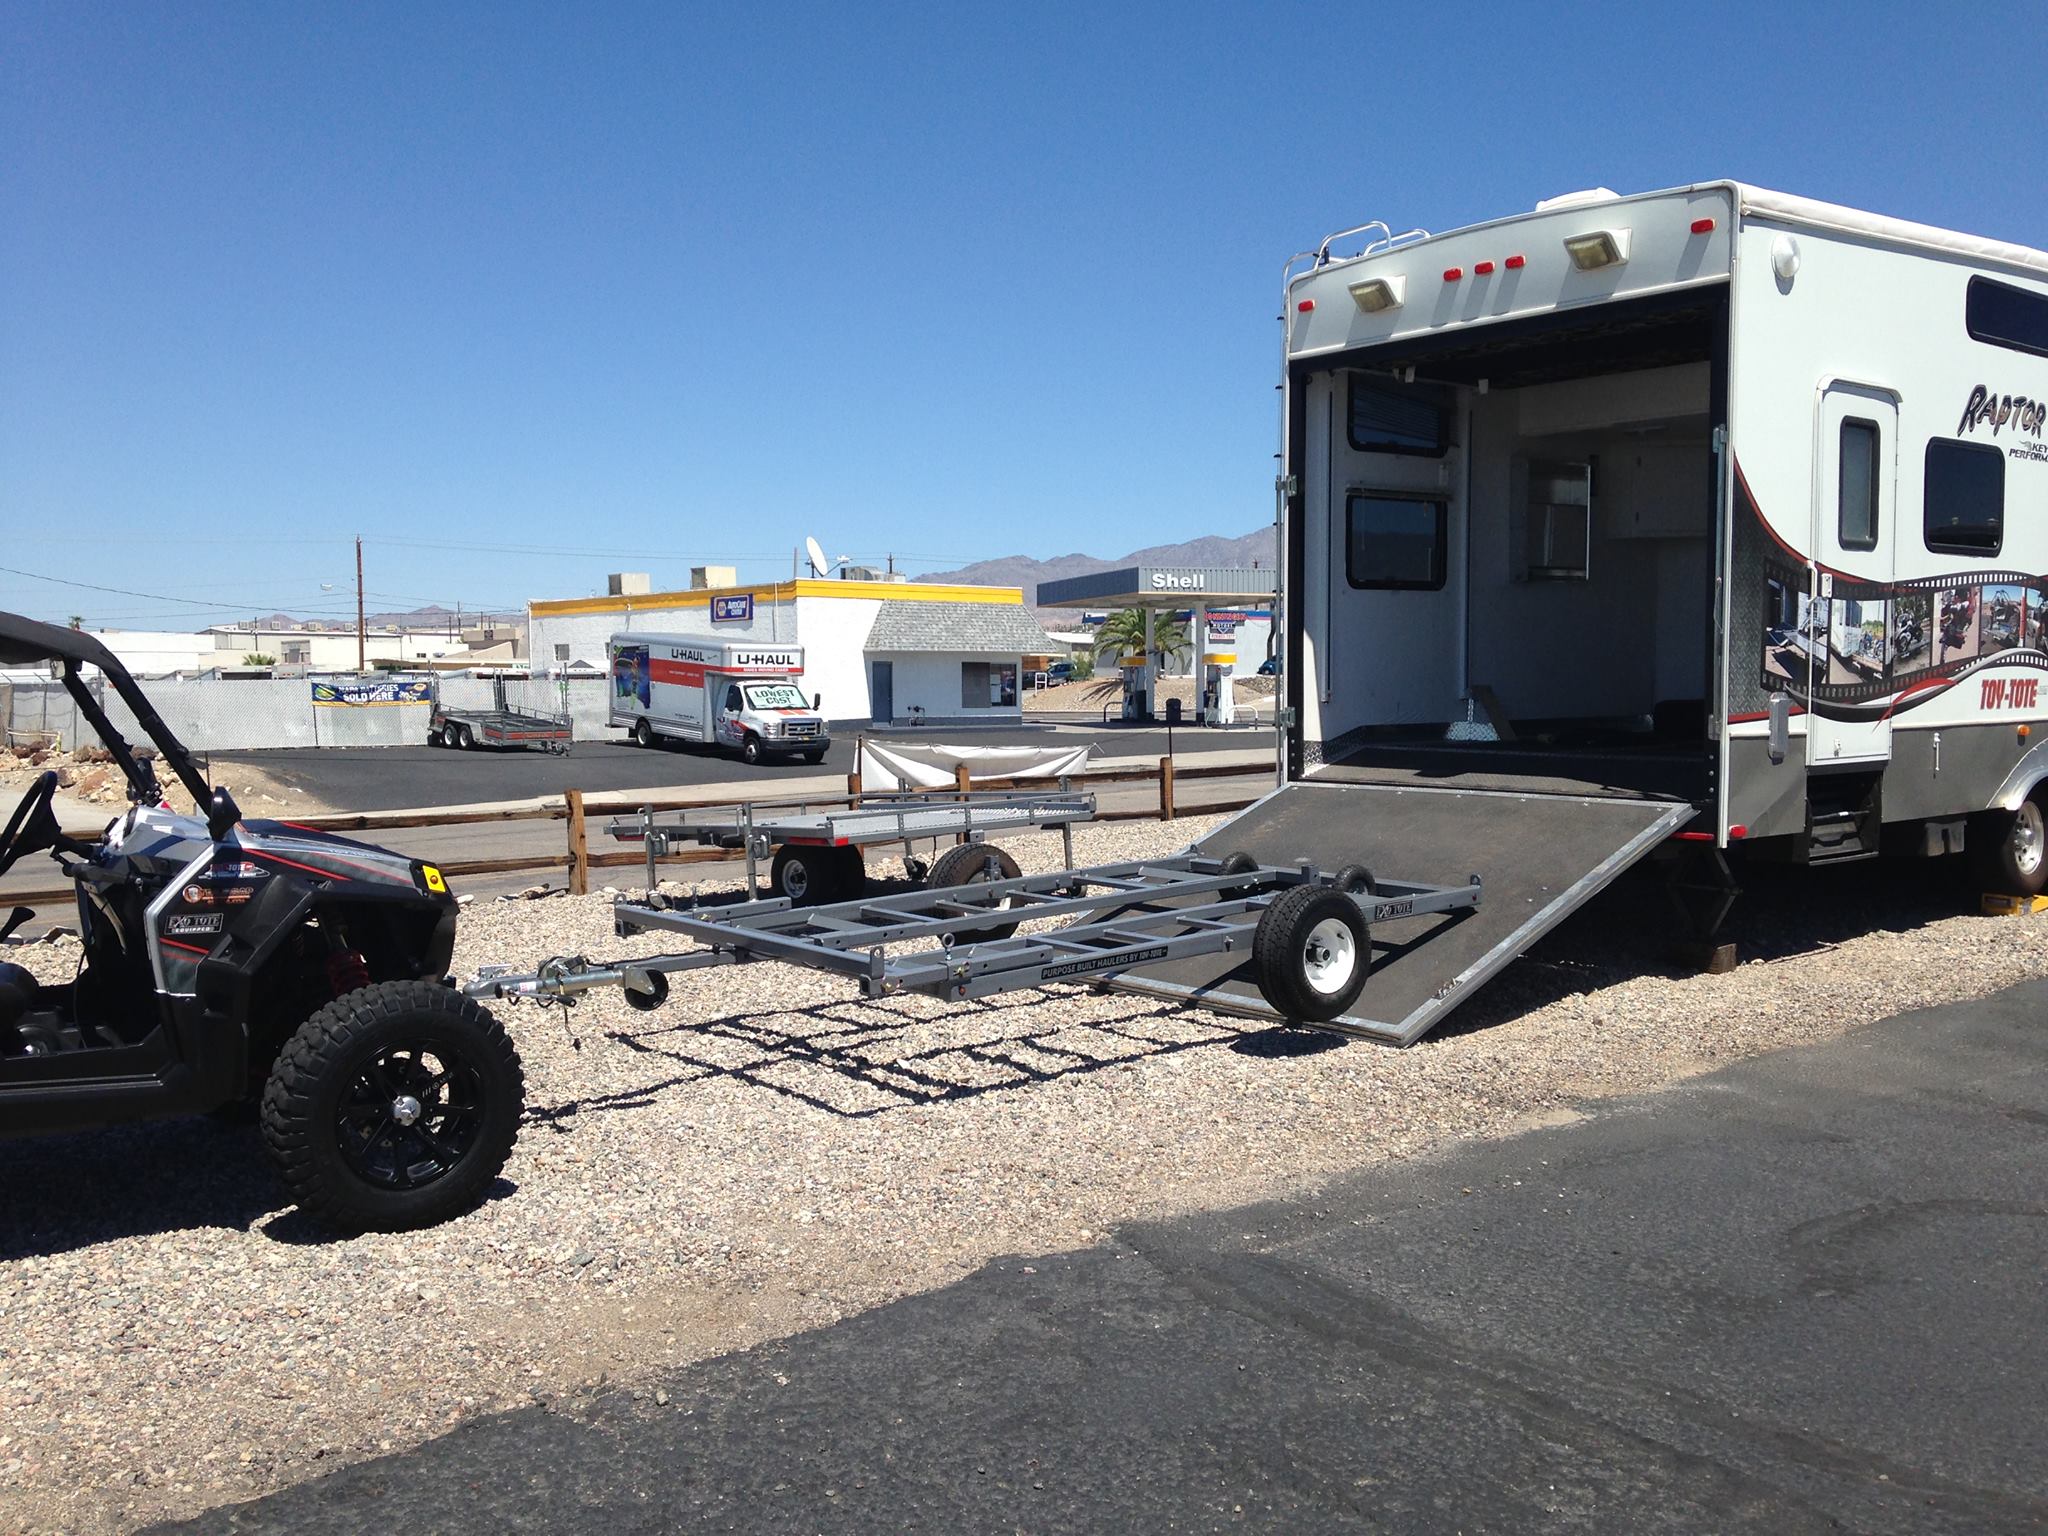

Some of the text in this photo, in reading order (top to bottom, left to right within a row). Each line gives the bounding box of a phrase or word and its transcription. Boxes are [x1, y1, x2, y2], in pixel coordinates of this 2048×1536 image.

[1957, 384, 2047, 439] RAPTOR
[1152, 573, 1205, 588] Shell
[671, 648, 705, 662] U-HAUL
[737, 654, 795, 665] U-HAUL
[343, 692, 394, 702] SOLD HERE
[754, 688, 796, 699] LOWEST
[765, 696, 793, 705] COST
[1980, 679, 2039, 710] TOY-TOTE
[167, 915, 221, 930] EXO TOTE
[1042, 965, 1076, 978] PURPOSE
[1077, 960, 1097, 971] BUILT
[1097, 955, 1129, 969] HAULERS
[1129, 952, 1139, 962] BY
